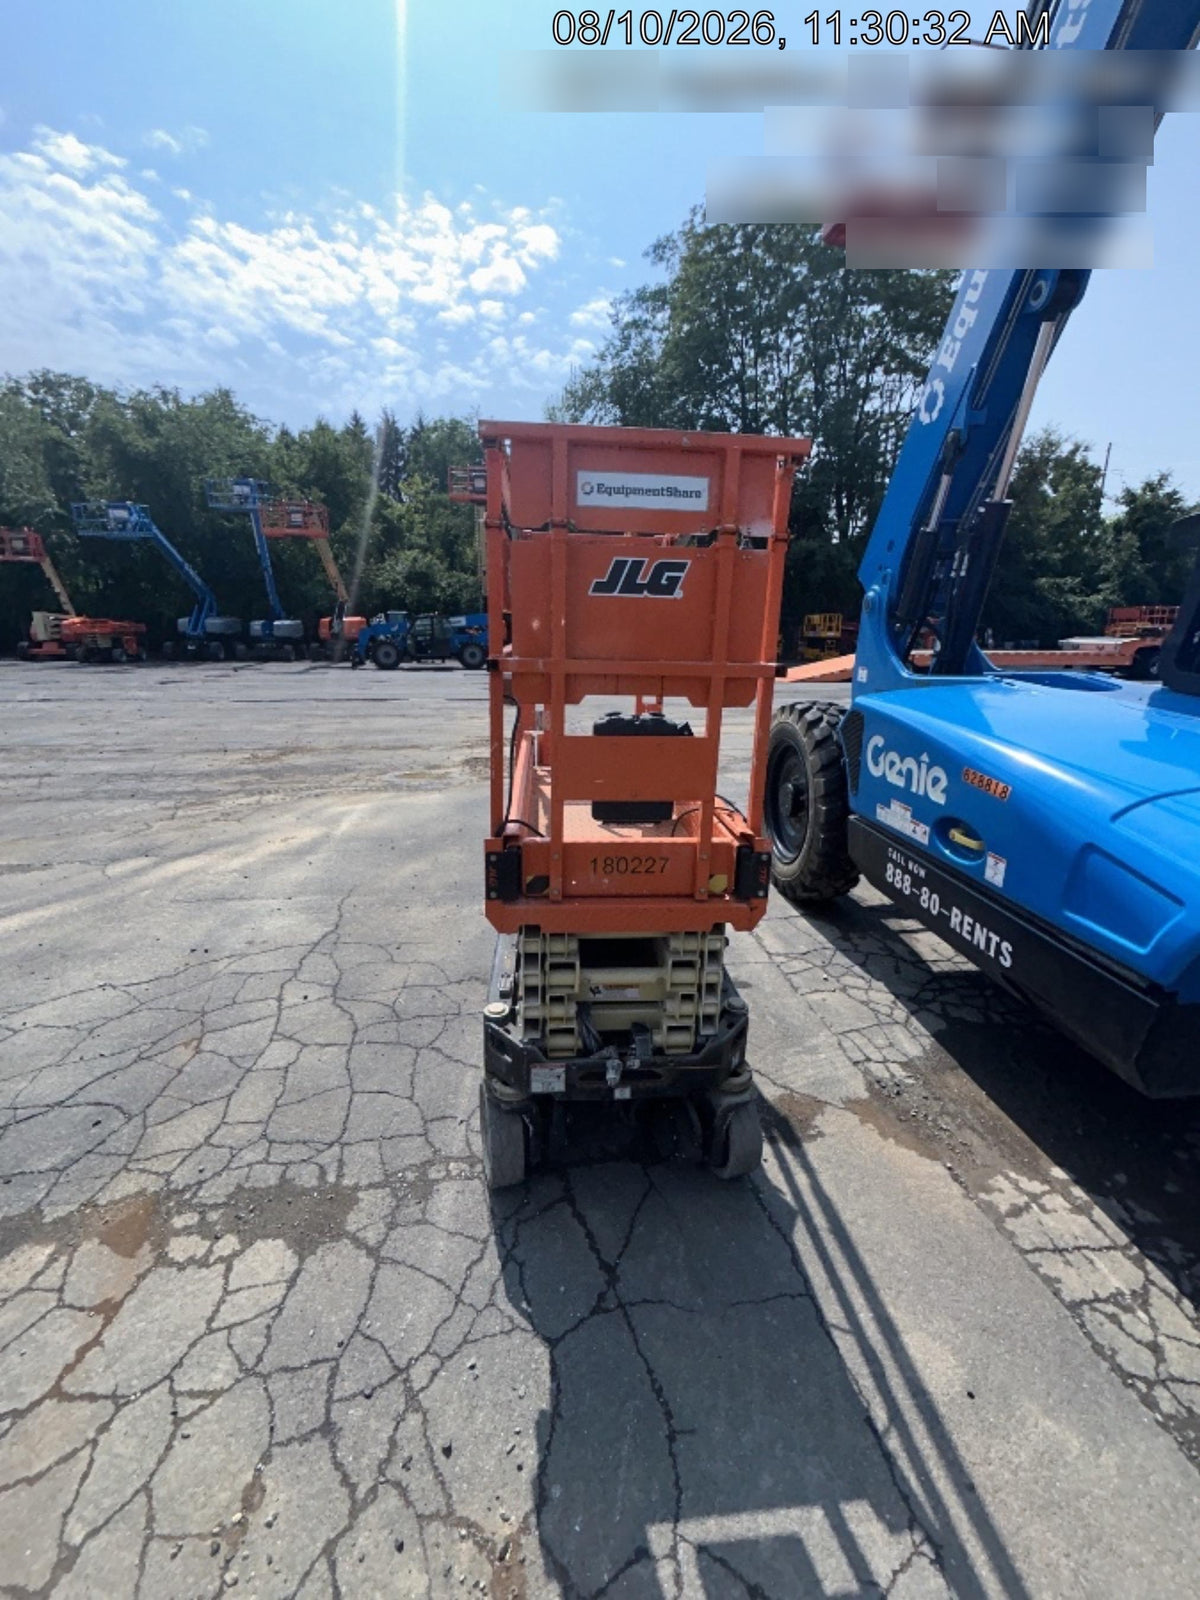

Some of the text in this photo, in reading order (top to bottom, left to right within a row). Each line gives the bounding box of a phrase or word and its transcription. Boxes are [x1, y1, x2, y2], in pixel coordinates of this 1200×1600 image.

[596, 483, 703, 499] EquipmentShare
[588, 556, 692, 598] JLG
[866, 735, 949, 806] Genie
[589, 856, 670, 876] 180227
[884, 862, 1014, 969] 888-80-RENTS
